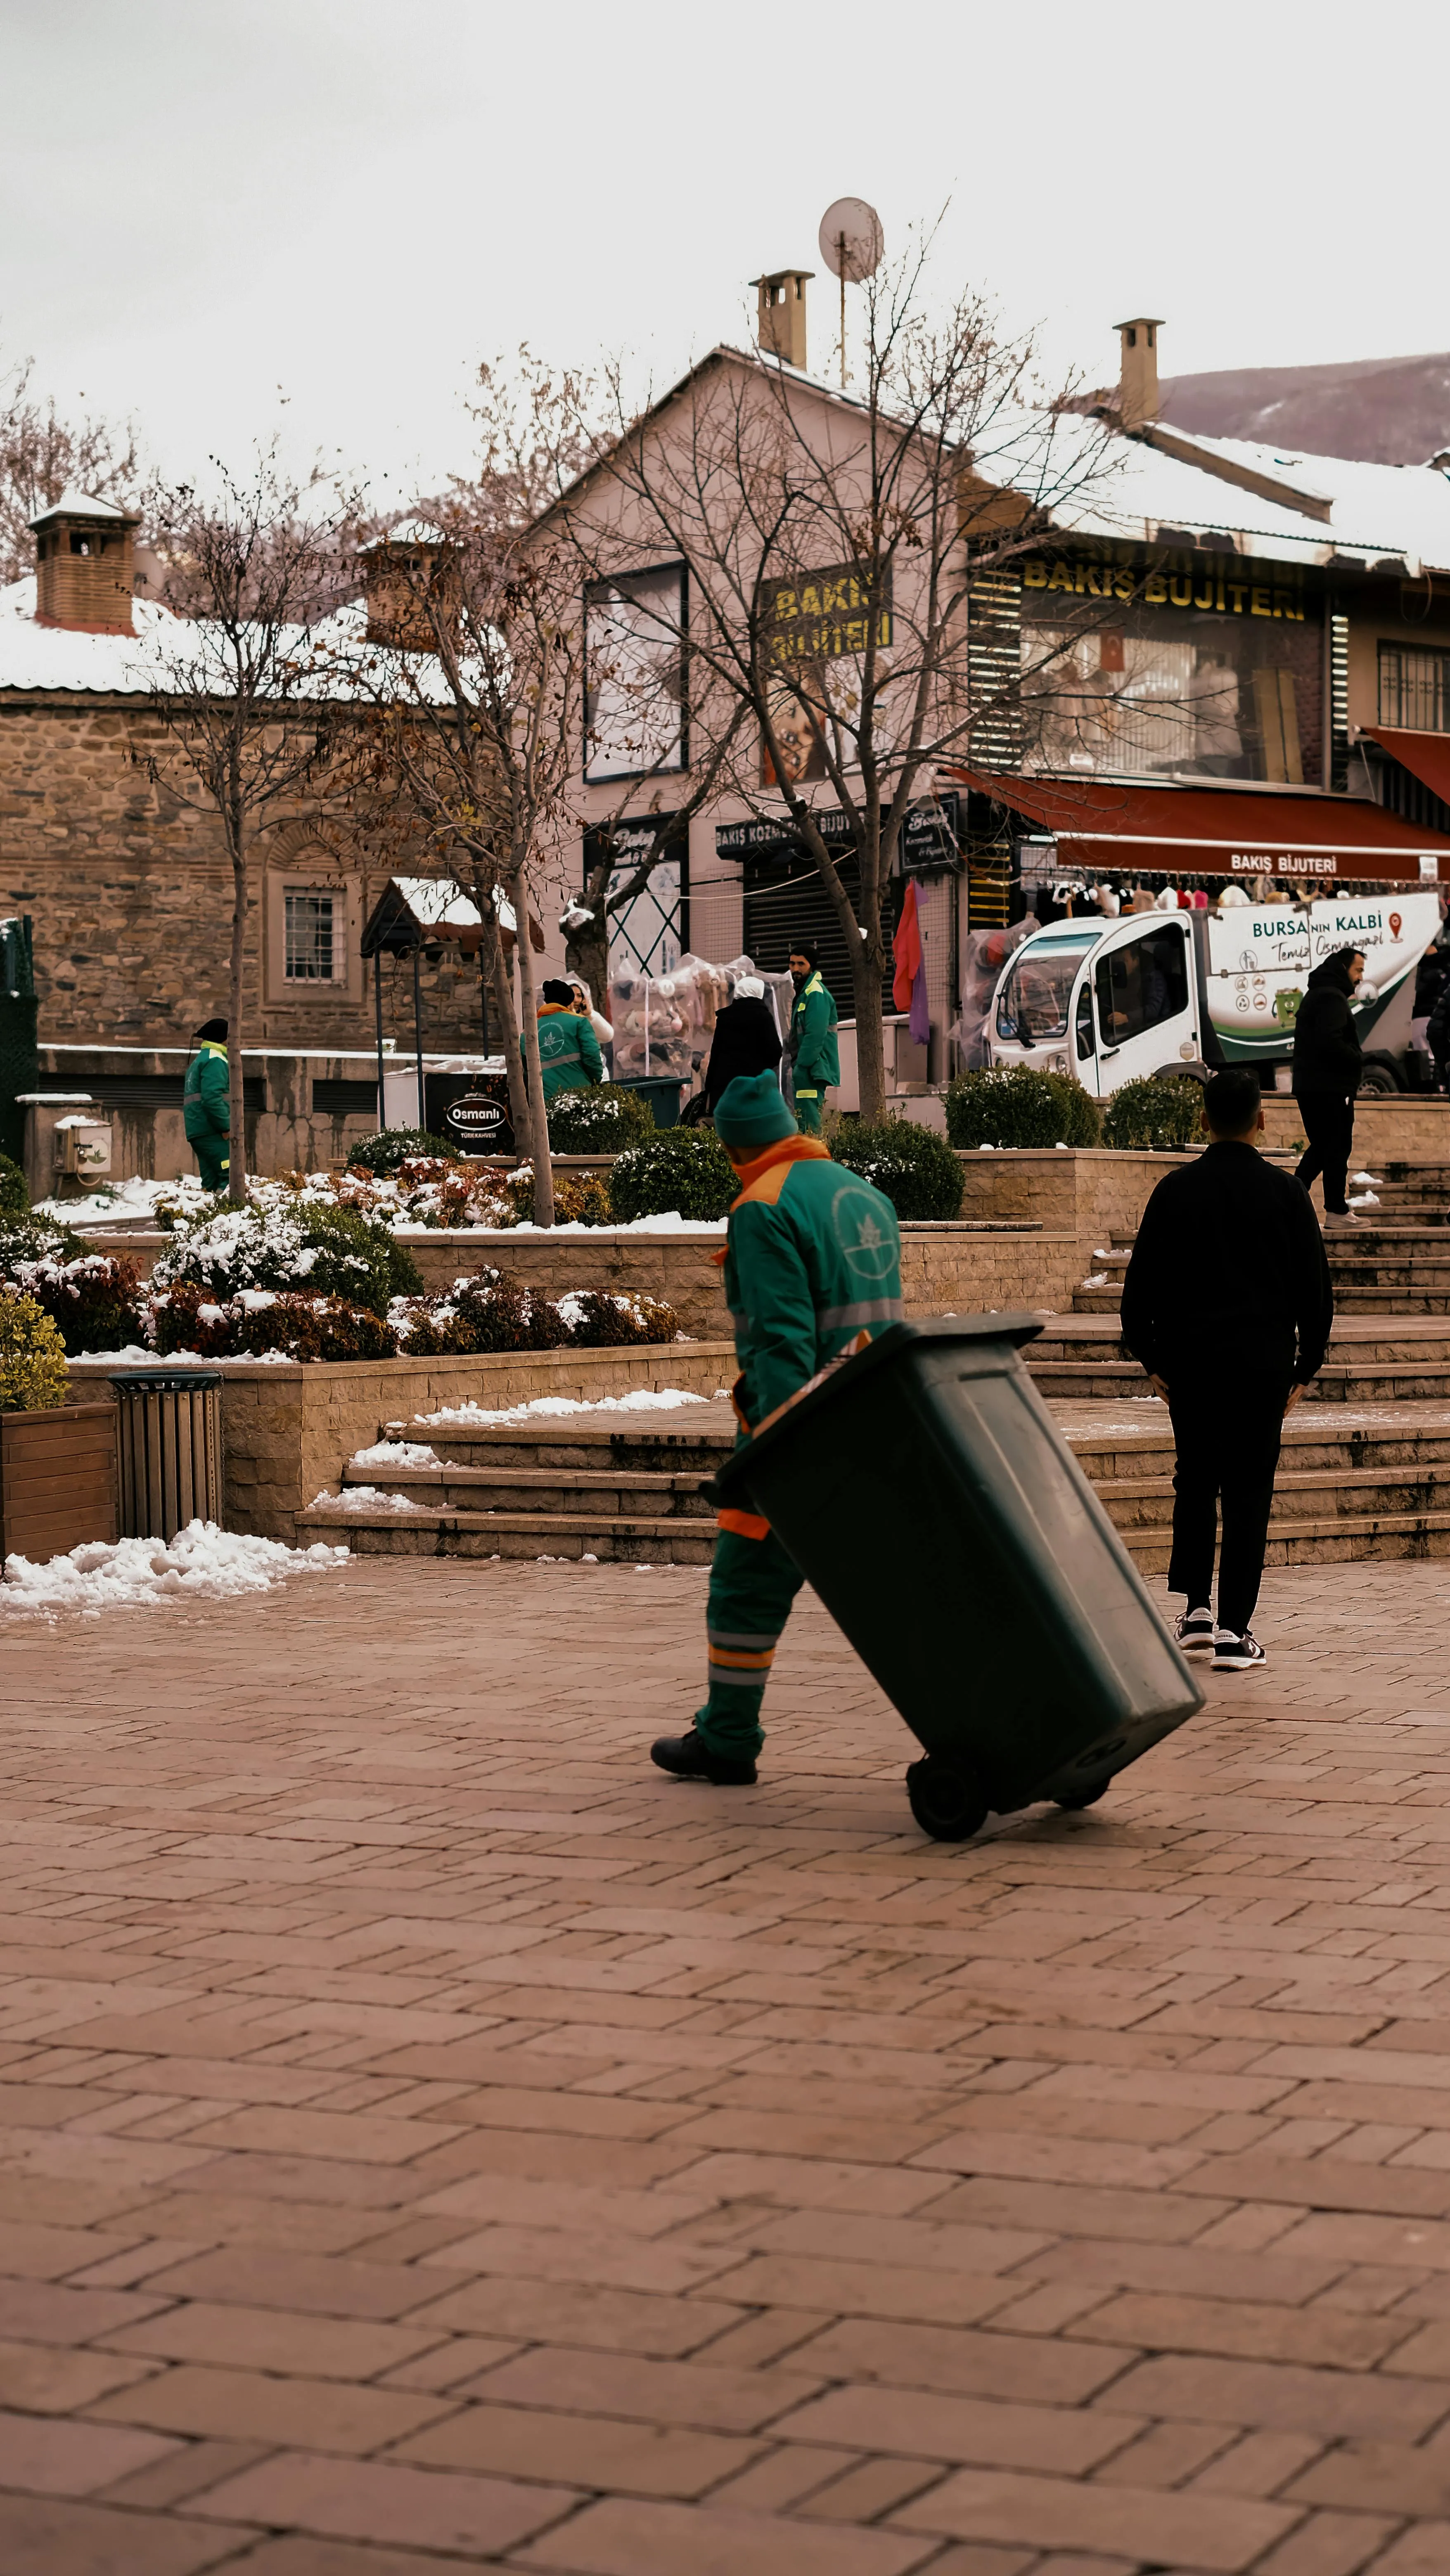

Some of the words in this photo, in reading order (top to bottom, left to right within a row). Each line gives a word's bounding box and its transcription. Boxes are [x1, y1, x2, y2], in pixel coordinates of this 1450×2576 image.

[716, 827, 745, 847] BAKIŞ
[1231, 854, 1273, 874] BAKIŞ
[1278, 853, 1337, 874] BİJUTERİ
[1336, 909, 1383, 932] KALBİ
[453, 1108, 500, 1120] Osmanlı
